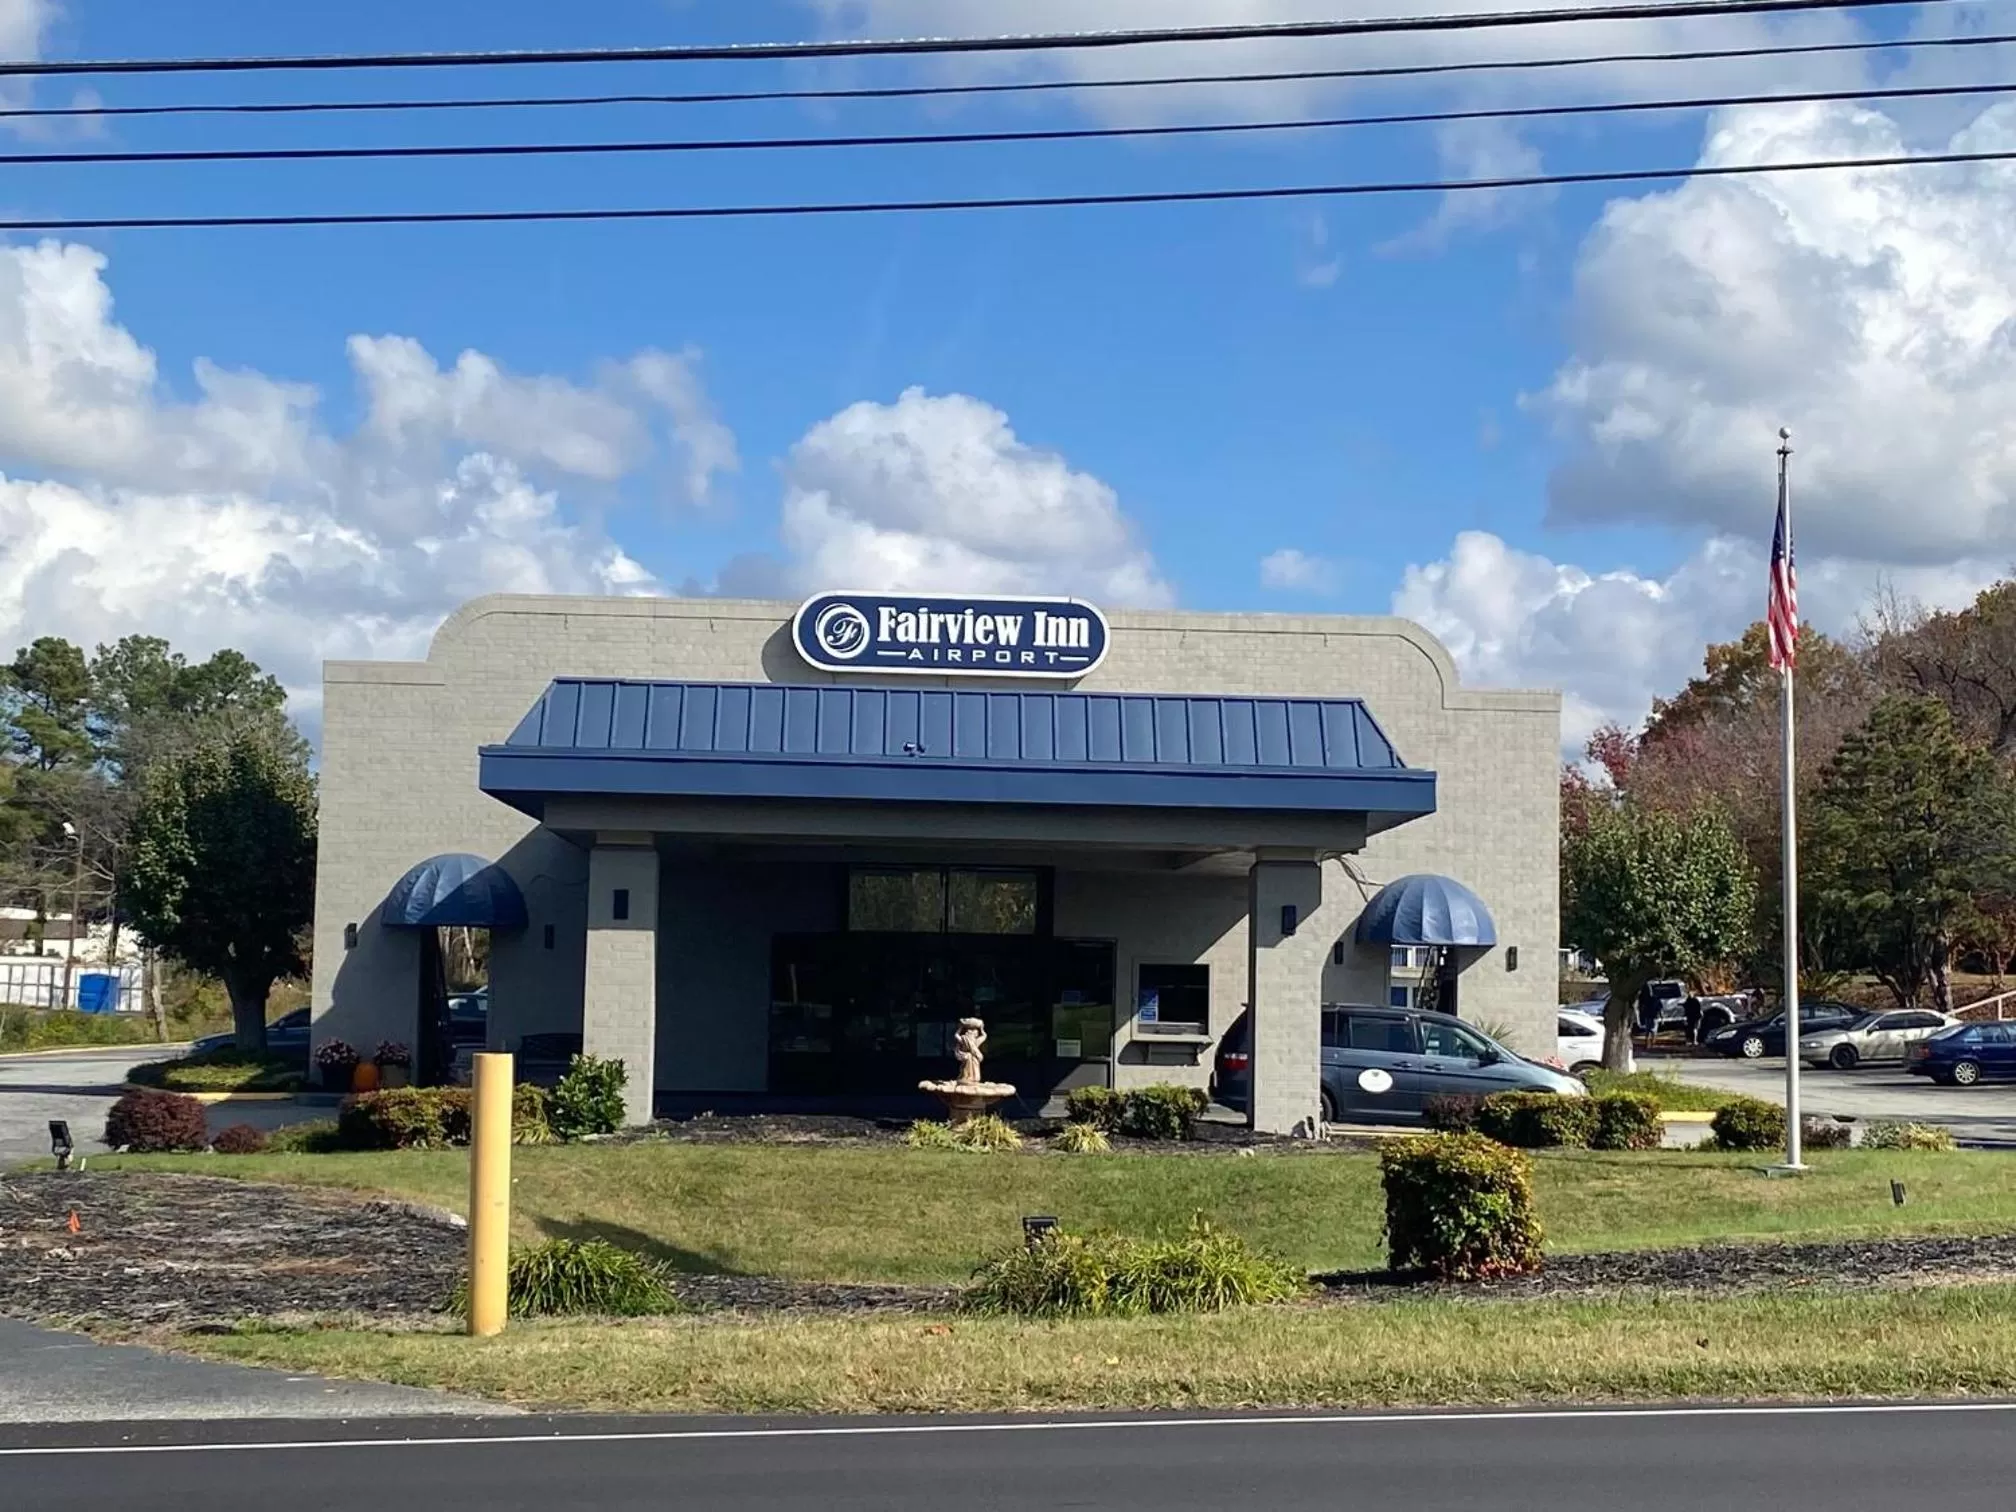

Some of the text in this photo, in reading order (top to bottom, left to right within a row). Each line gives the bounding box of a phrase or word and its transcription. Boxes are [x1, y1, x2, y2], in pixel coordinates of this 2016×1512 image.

[877, 606, 1090, 647] Fairview Inn
[908, 647, 1058, 664] AIRPORT
